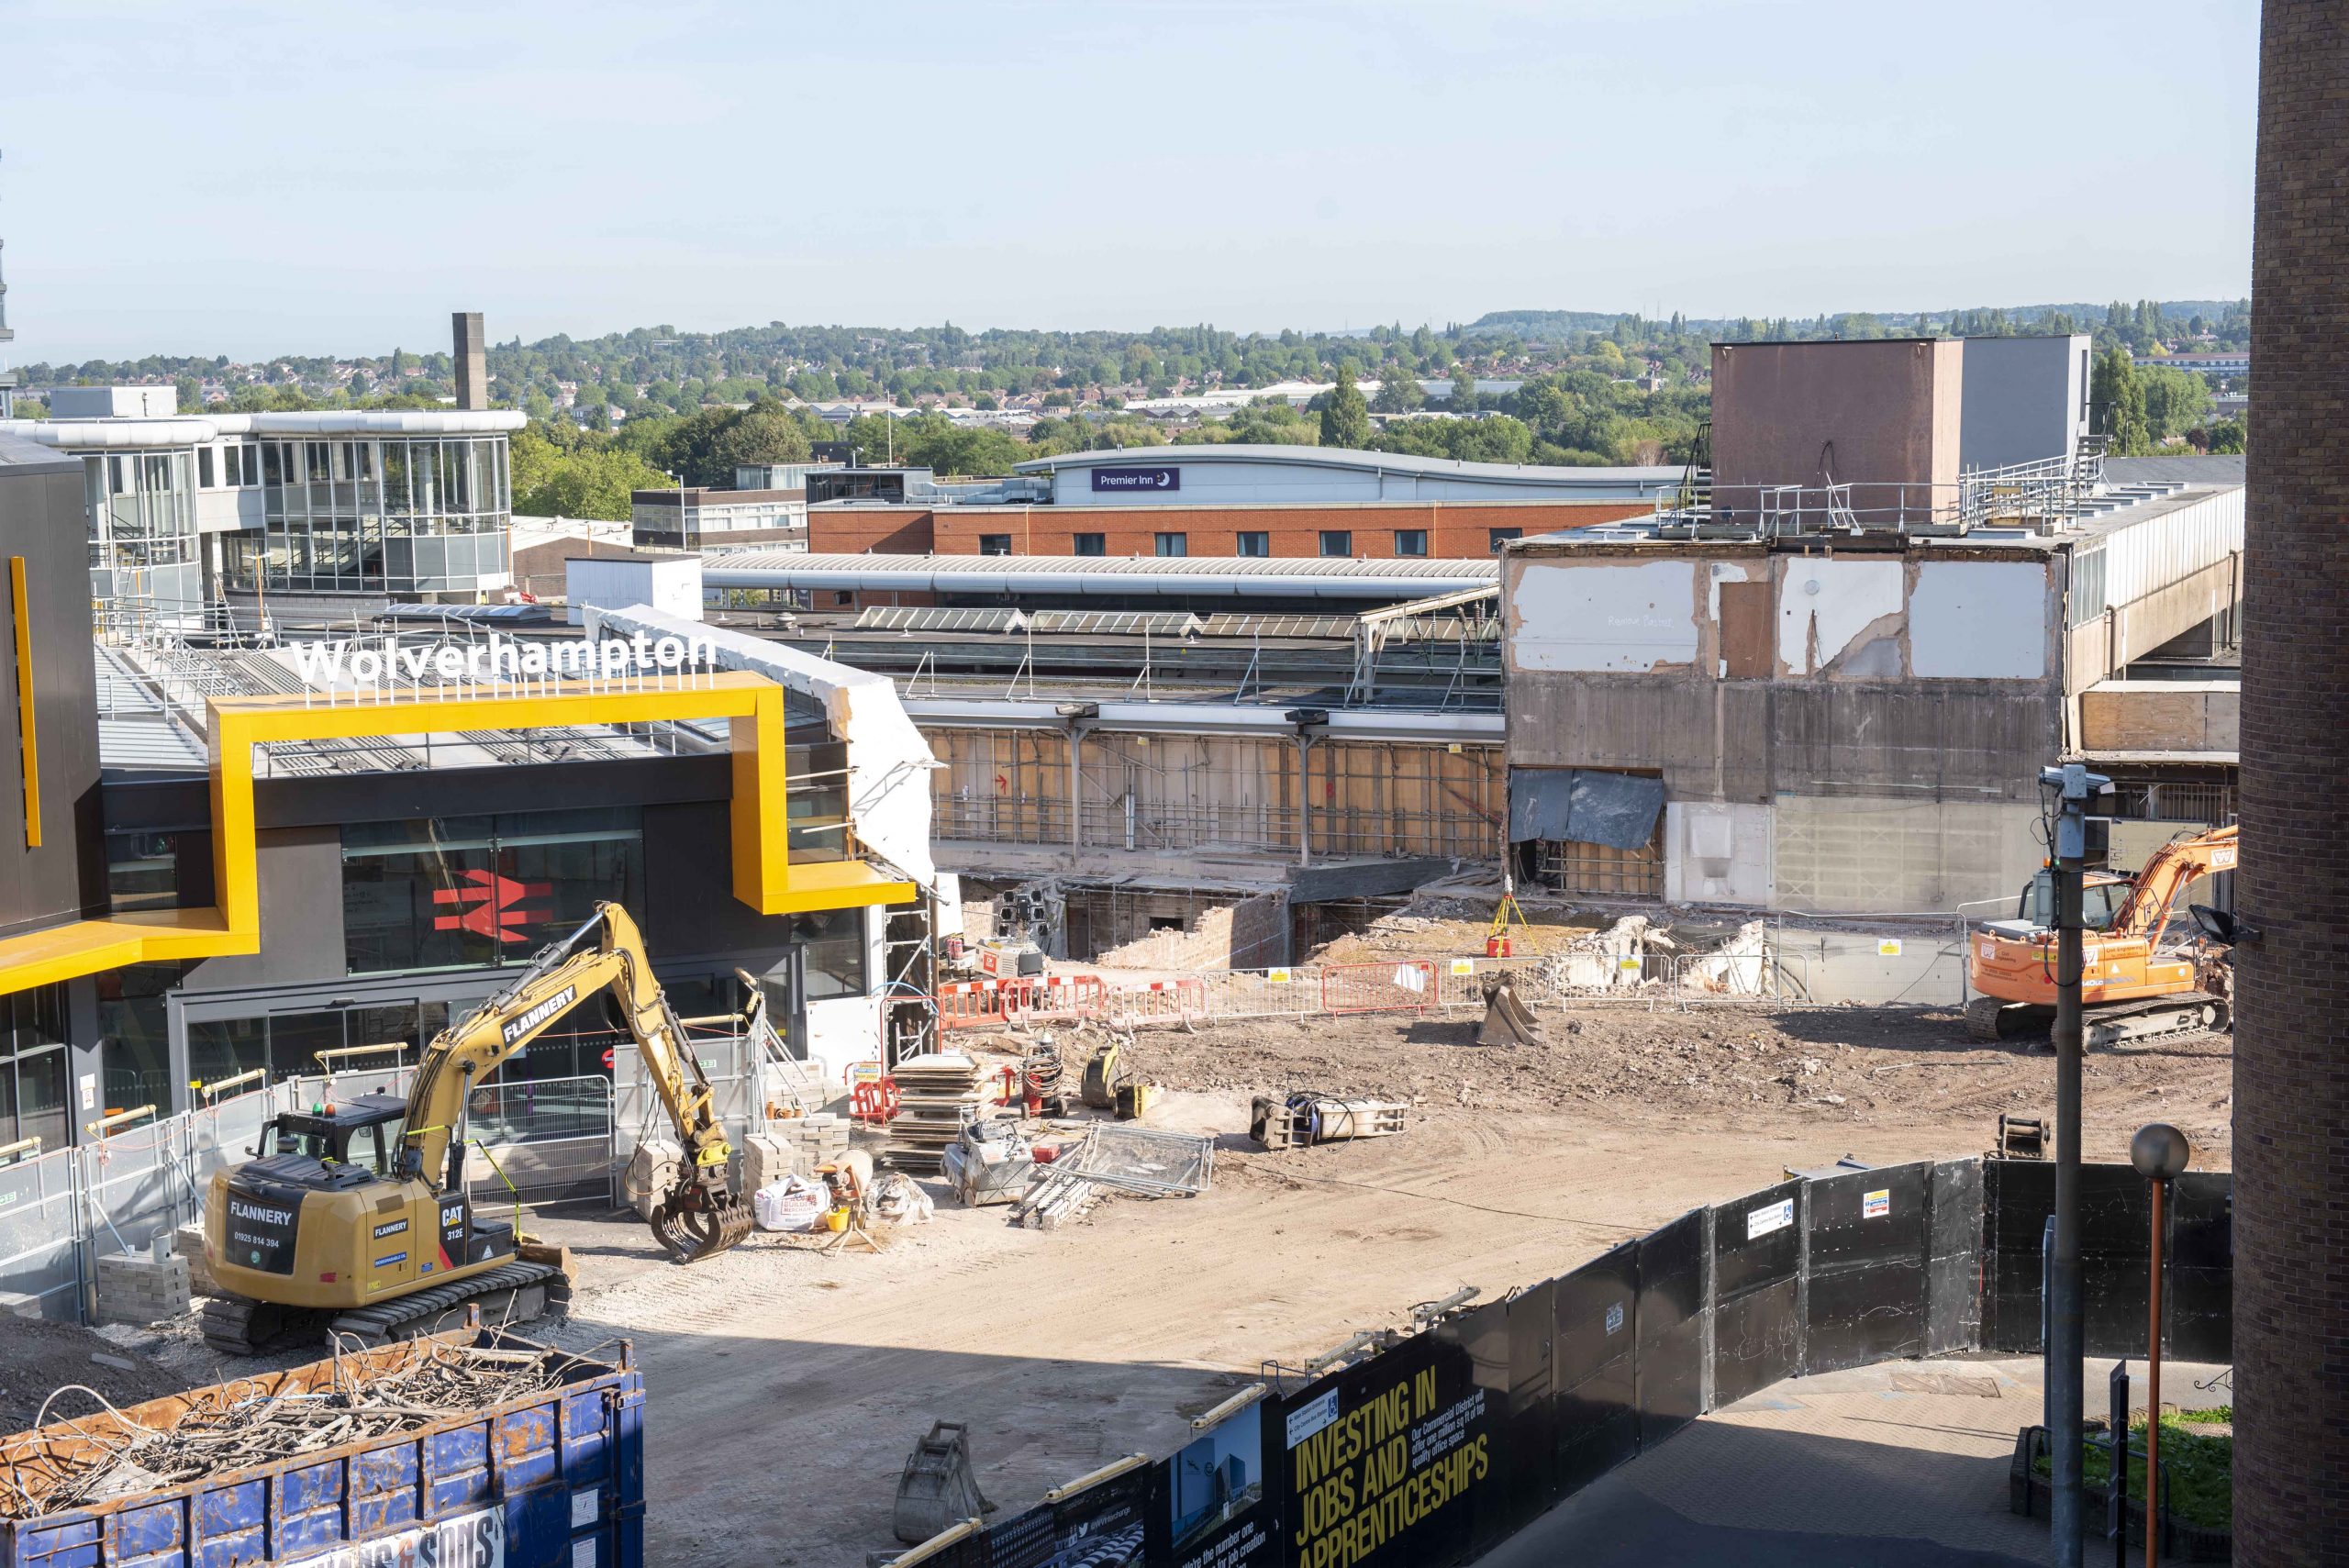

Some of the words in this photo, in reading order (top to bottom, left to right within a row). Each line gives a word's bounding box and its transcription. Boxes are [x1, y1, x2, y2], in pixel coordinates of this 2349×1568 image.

[1100, 475, 1138, 485] Premier
[1139, 475, 1153, 484] Inn
[289, 629, 717, 683] Wolverhampton
[503, 985, 573, 1043] FLANNERY
[230, 1201, 292, 1226] FLANNERY
[374, 1220, 407, 1237] FLANNERY
[441, 1205, 463, 1228] CAT
[234, 1231, 251, 1243] 01925
[252, 1236, 265, 1246] 814
[265, 1239, 280, 1248] 394
[447, 1228, 463, 1240] 312E
[1300, 1418, 1311, 1428] Centre
[1317, 1408, 1328, 1418] Station
[1301, 1407, 1312, 1417] Station
[1312, 1399, 1326, 1410] Entrance
[1411, 1427, 1422, 1441] Our
[1422, 1405, 1455, 1435] Commercial
[1455, 1395, 1475, 1416] District
[1475, 1387, 1485, 1404] will
[1296, 1381, 1409, 1494] INVESTING
[1416, 1364, 1436, 1419] IN
[1411, 1439, 1426, 1455] offer
[1426, 1432, 1437, 1446] one
[1438, 1420, 1456, 1440] million
[1456, 1417, 1464, 1429] sq
[1464, 1410, 1470, 1423] ft
[1470, 1406, 1476, 1420] of
[1475, 1402, 1486, 1416] top
[1412, 1449, 1431, 1471] quality
[1431, 1439, 1448, 1457] office
[1448, 1429, 1465, 1447] space
[1296, 1466, 1355, 1546] JOBS
[1362, 1434, 1408, 1505] AND
[418, 1516, 495, 1568] SONS
[1203, 1549, 1215, 1565] the
[1215, 1529, 1241, 1557] number
[1241, 1521, 1254, 1539] one
[1228, 1548, 1239, 1568] job
[1240, 1531, 1266, 1558] creation
